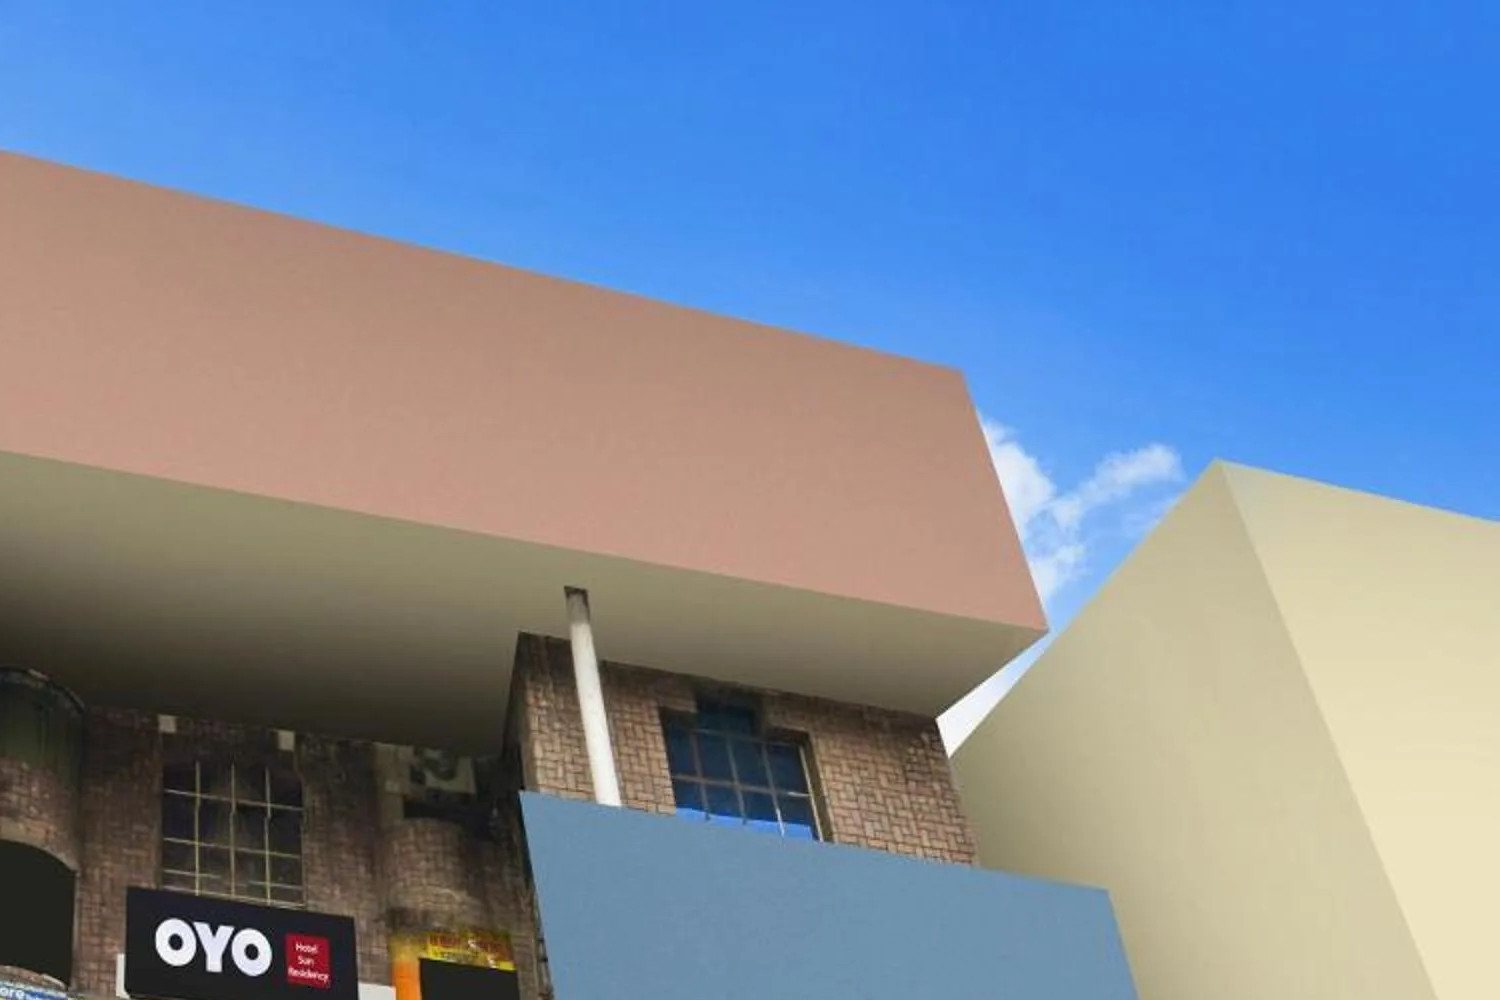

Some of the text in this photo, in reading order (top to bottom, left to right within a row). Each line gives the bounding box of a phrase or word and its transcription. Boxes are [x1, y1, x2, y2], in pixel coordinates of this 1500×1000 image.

[155, 917, 273, 977] OYO
[295, 941, 318, 953] Hotel
[287, 967, 329, 982] Residency
